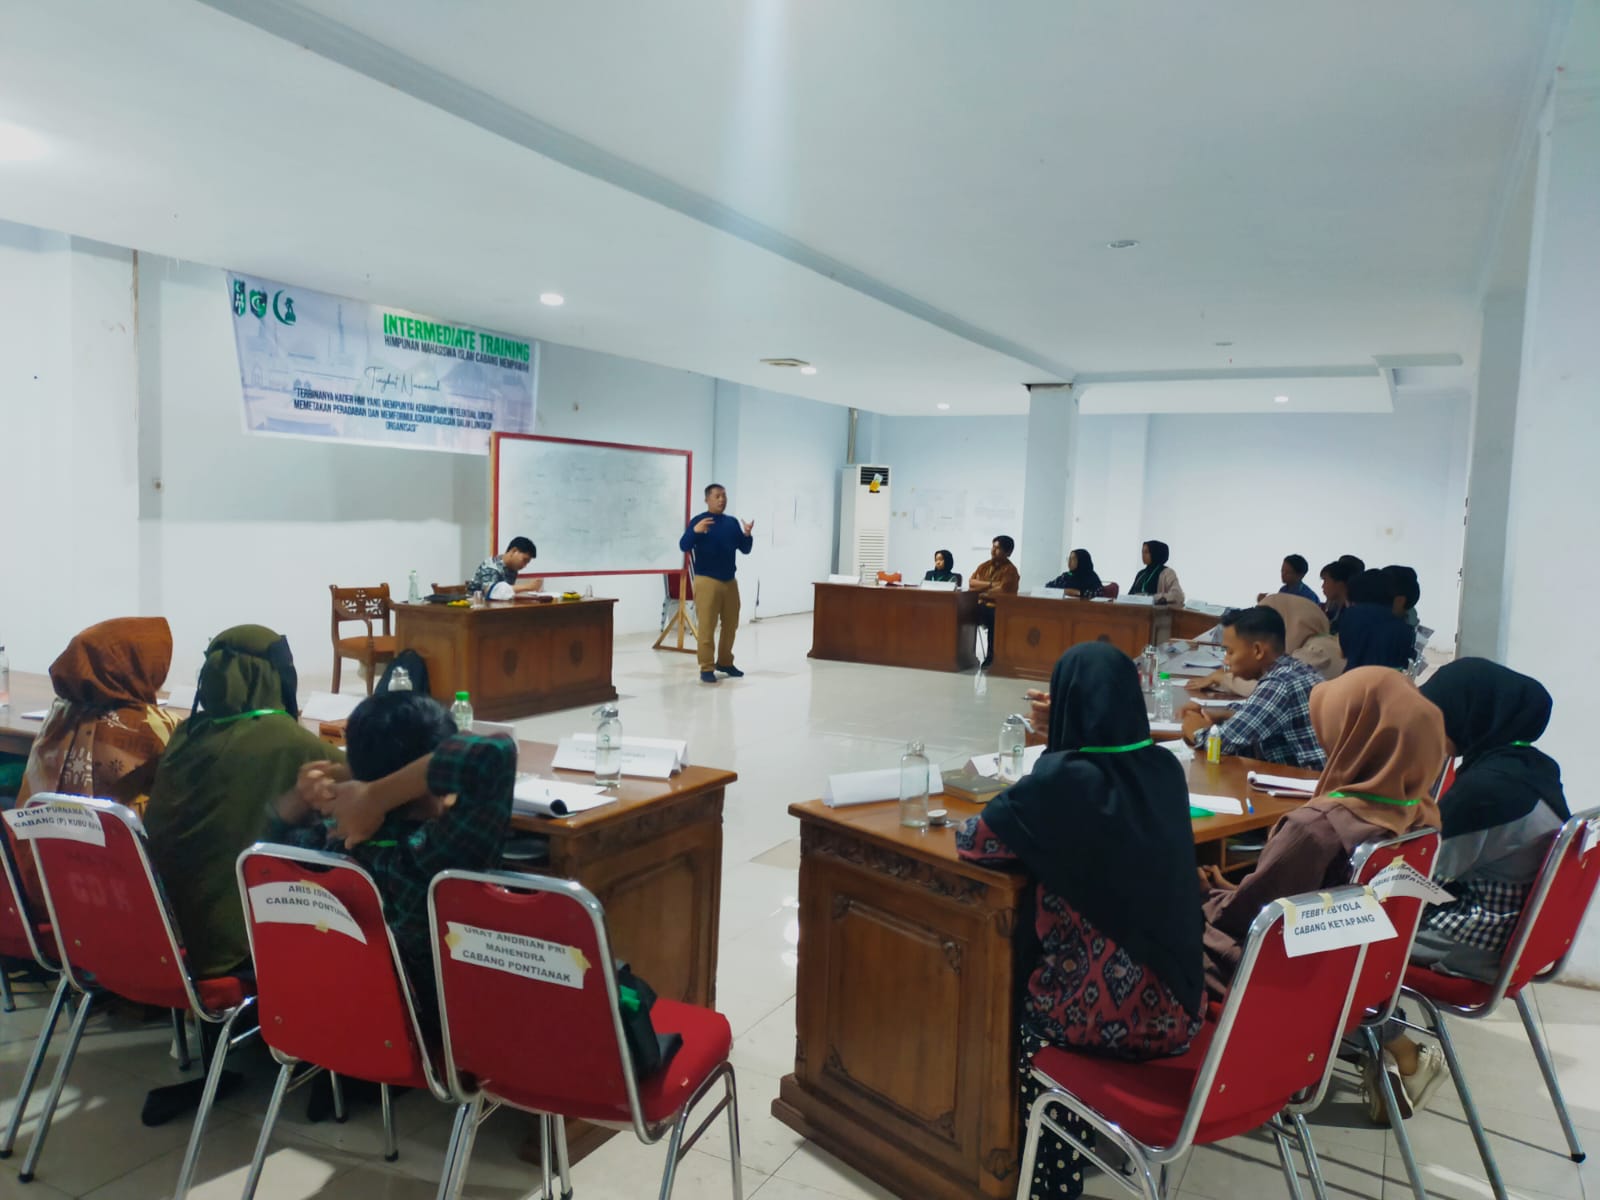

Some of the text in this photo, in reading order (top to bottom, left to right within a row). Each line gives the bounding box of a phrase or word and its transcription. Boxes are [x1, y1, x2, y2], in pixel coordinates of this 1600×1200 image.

[384, 312, 530, 362] INTERMEDIATE TRAINING
[16, 806, 44, 818] DEWI
[14, 816, 55, 828] CABANG
[69, 818, 87, 828] KUBU
[288, 885, 312, 895] ARIS
[266, 897, 354, 922] CABANG PONTI
[1294, 914, 1376, 936] CABANG KETAPANG
[496, 934, 545, 950] ANDRIAN
[485, 943, 546, 962] MAHENDRA
[462, 950, 571, 982] CABANG PONTIANAK
